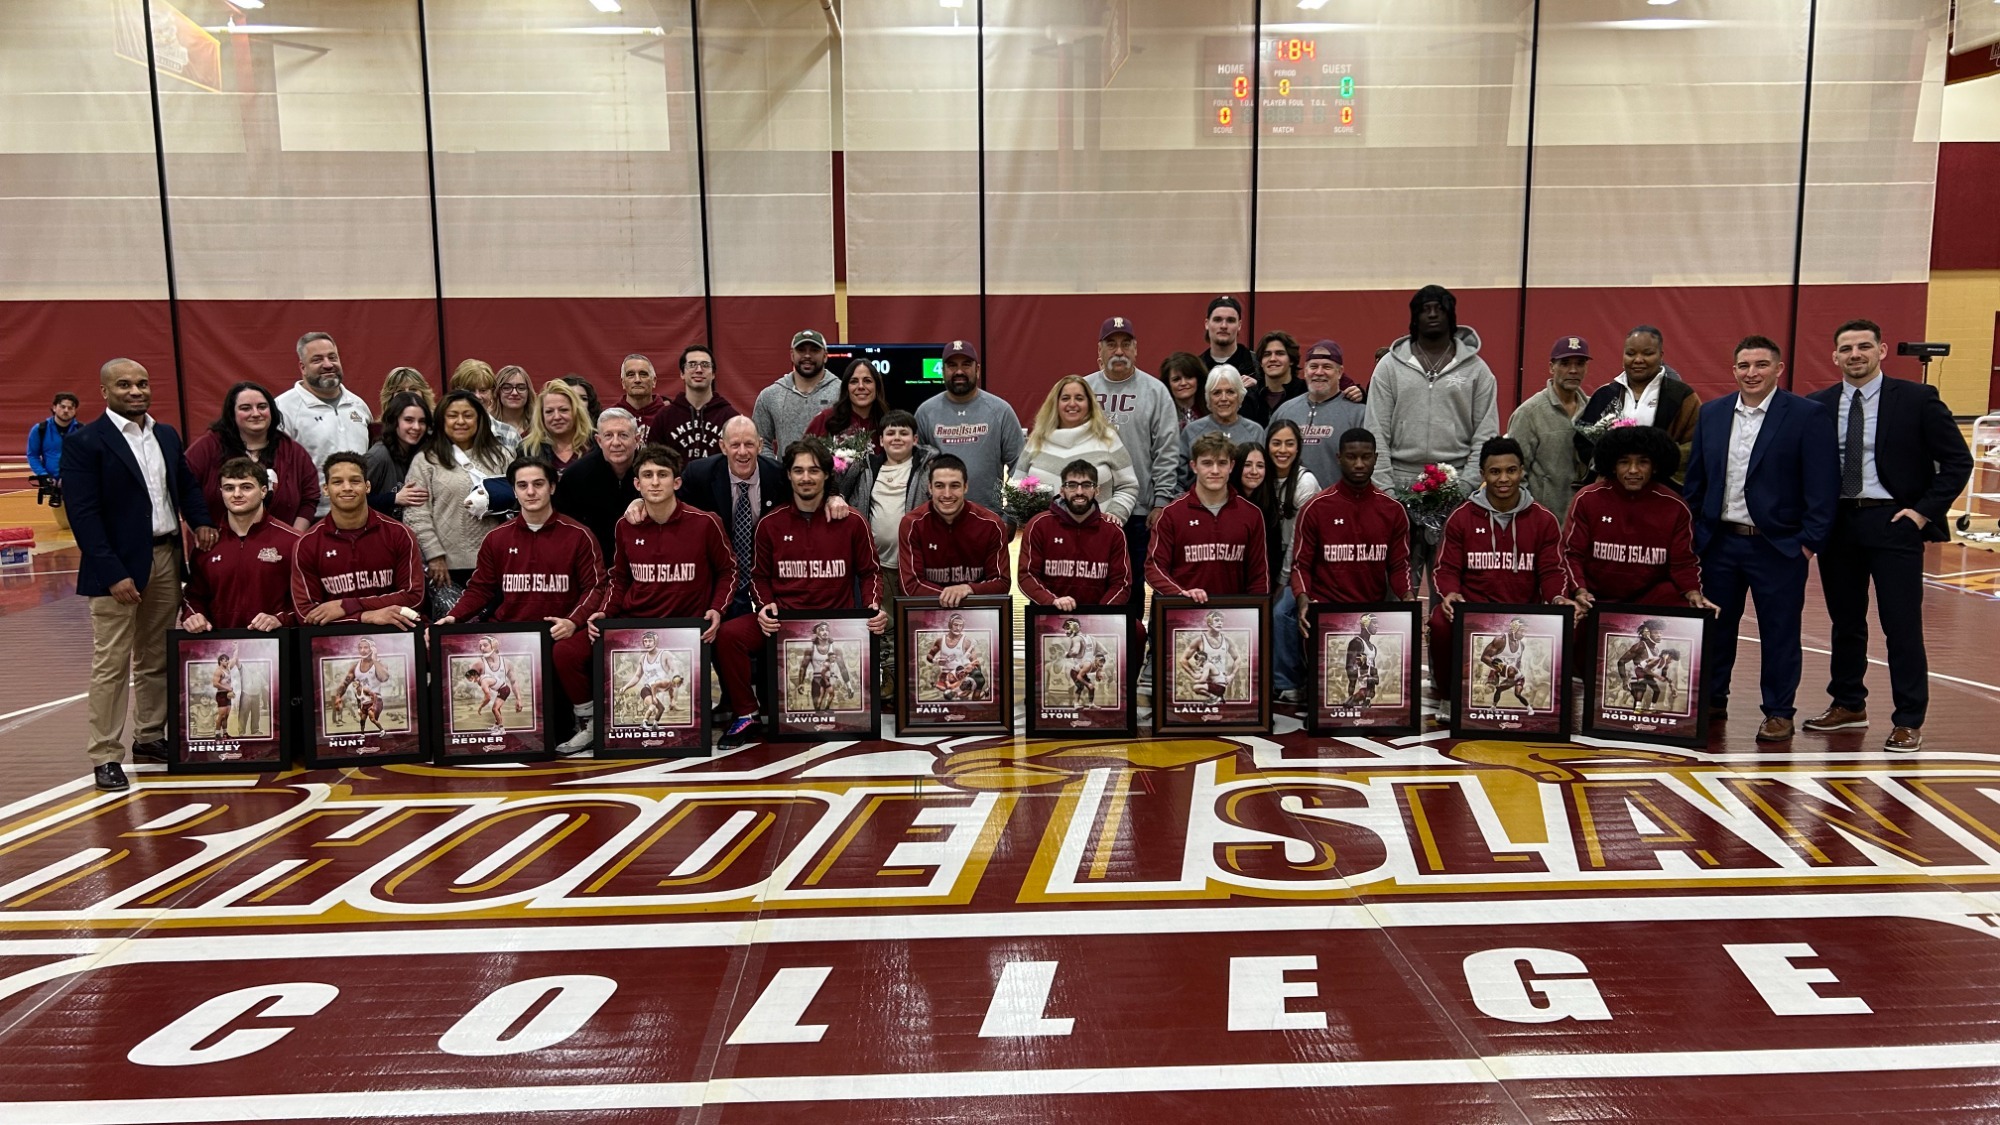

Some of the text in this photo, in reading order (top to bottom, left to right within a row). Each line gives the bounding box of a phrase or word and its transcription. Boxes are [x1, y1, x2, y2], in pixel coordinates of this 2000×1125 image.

[1218, 64, 1244, 74] HOME
[1322, 64, 1352, 74] GUEST
[1234, 76, 1249, 98] 0
[1279, 78, 1290, 97] 0
[1340, 76, 1354, 98] 0
[1219, 107, 1231, 125] 0
[1341, 107, 1353, 124] 0
[1094, 394, 1136, 412] RIC
[961, 425, 987, 435] ISLAND
[679, 433, 718, 448] EAGLE
[1184, 544, 1214, 562] RHODE
[1324, 544, 1355, 561] RHODE
[1467, 552, 1500, 570] RHODE
[1593, 541, 1666, 565] RHODE ISLAND
[657, 563, 695, 582] ISLAND
[778, 560, 845, 578] RHODE ISLAND
[1045, 560, 1074, 577] RHODE
[321, 569, 393, 594] RHODE ISLAND
[532, 574, 569, 592] ISLAND
[1469, 713, 1519, 721] CARTER
[1602, 713, 1677, 725] RODRIGUEZ
[608, 731, 675, 739] LUNDBERG
[0, 780, 1000, 920] RHODE
[127, 942, 1874, 1067] COLLEGE
